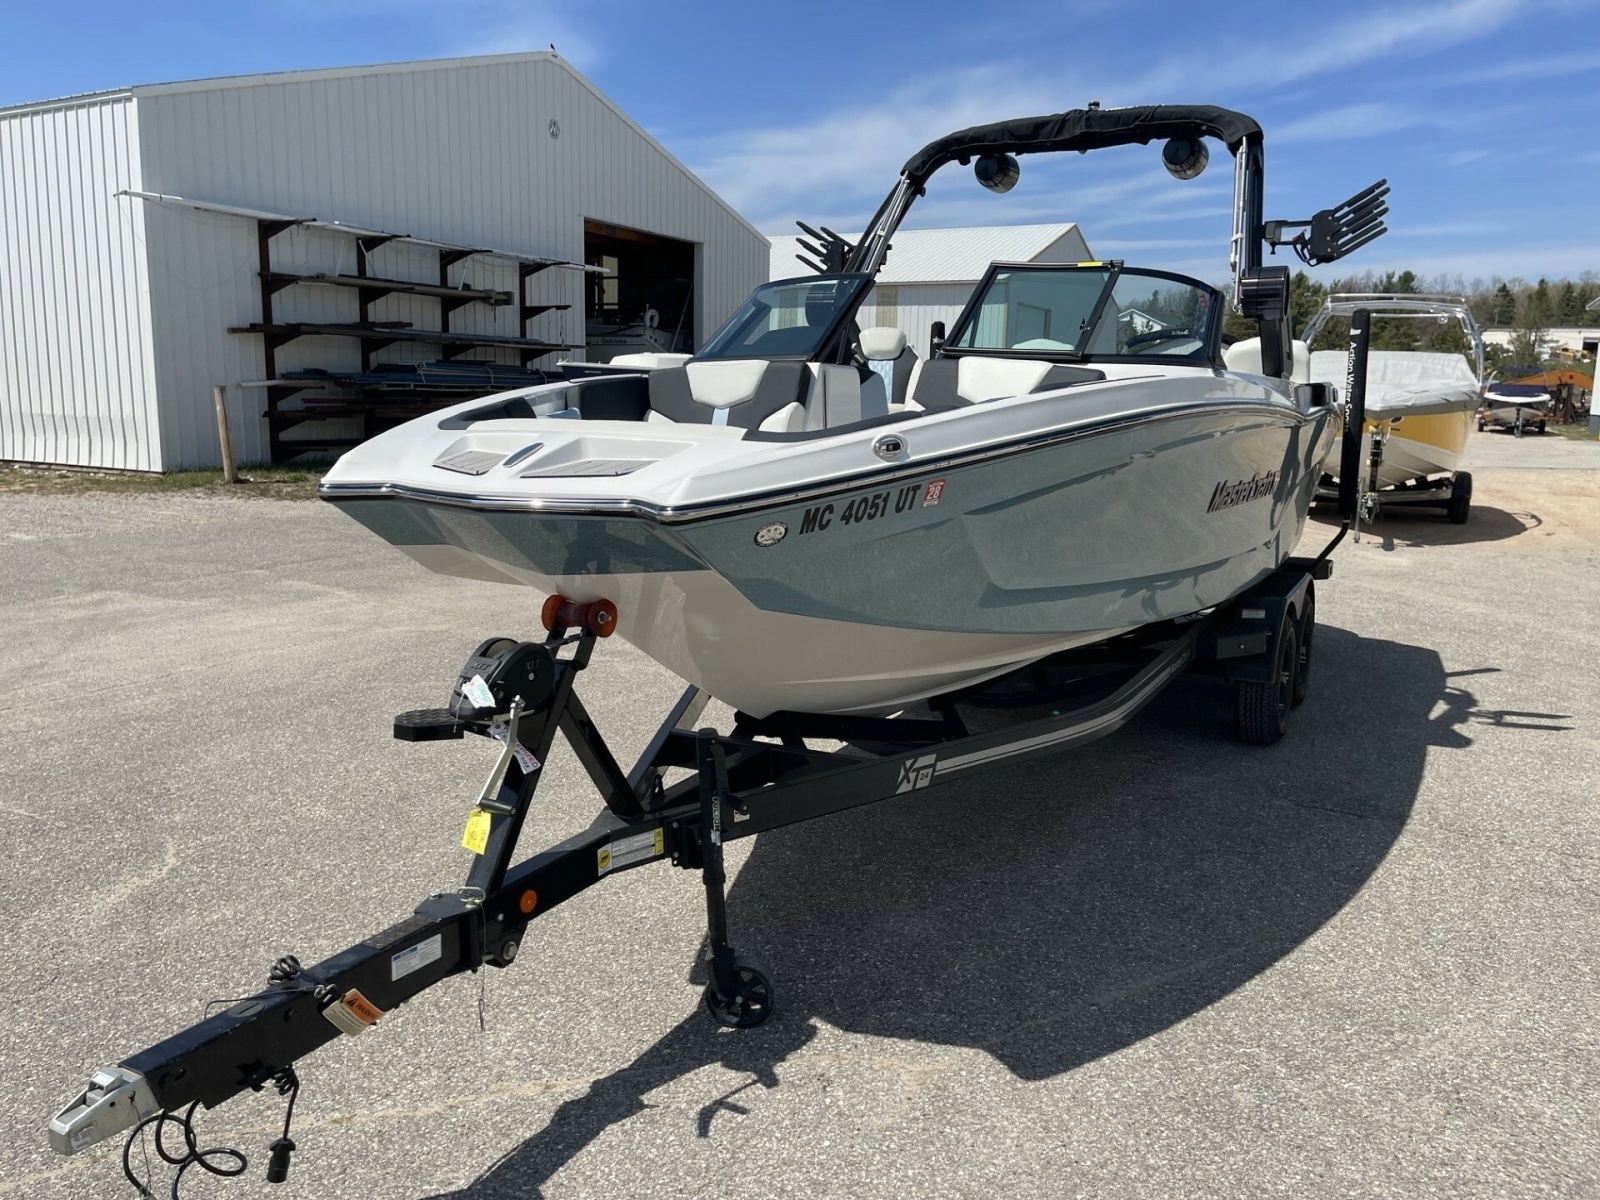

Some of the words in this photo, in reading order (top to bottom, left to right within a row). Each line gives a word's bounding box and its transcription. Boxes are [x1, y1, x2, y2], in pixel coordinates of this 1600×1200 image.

[1347, 341, 1357, 372] Action
[1345, 373, 1355, 402] Water
[926, 485, 942, 500] 28
[799, 504, 834, 535] MC
[840, 491, 891, 525] 4051
[894, 484, 922, 514] UT
